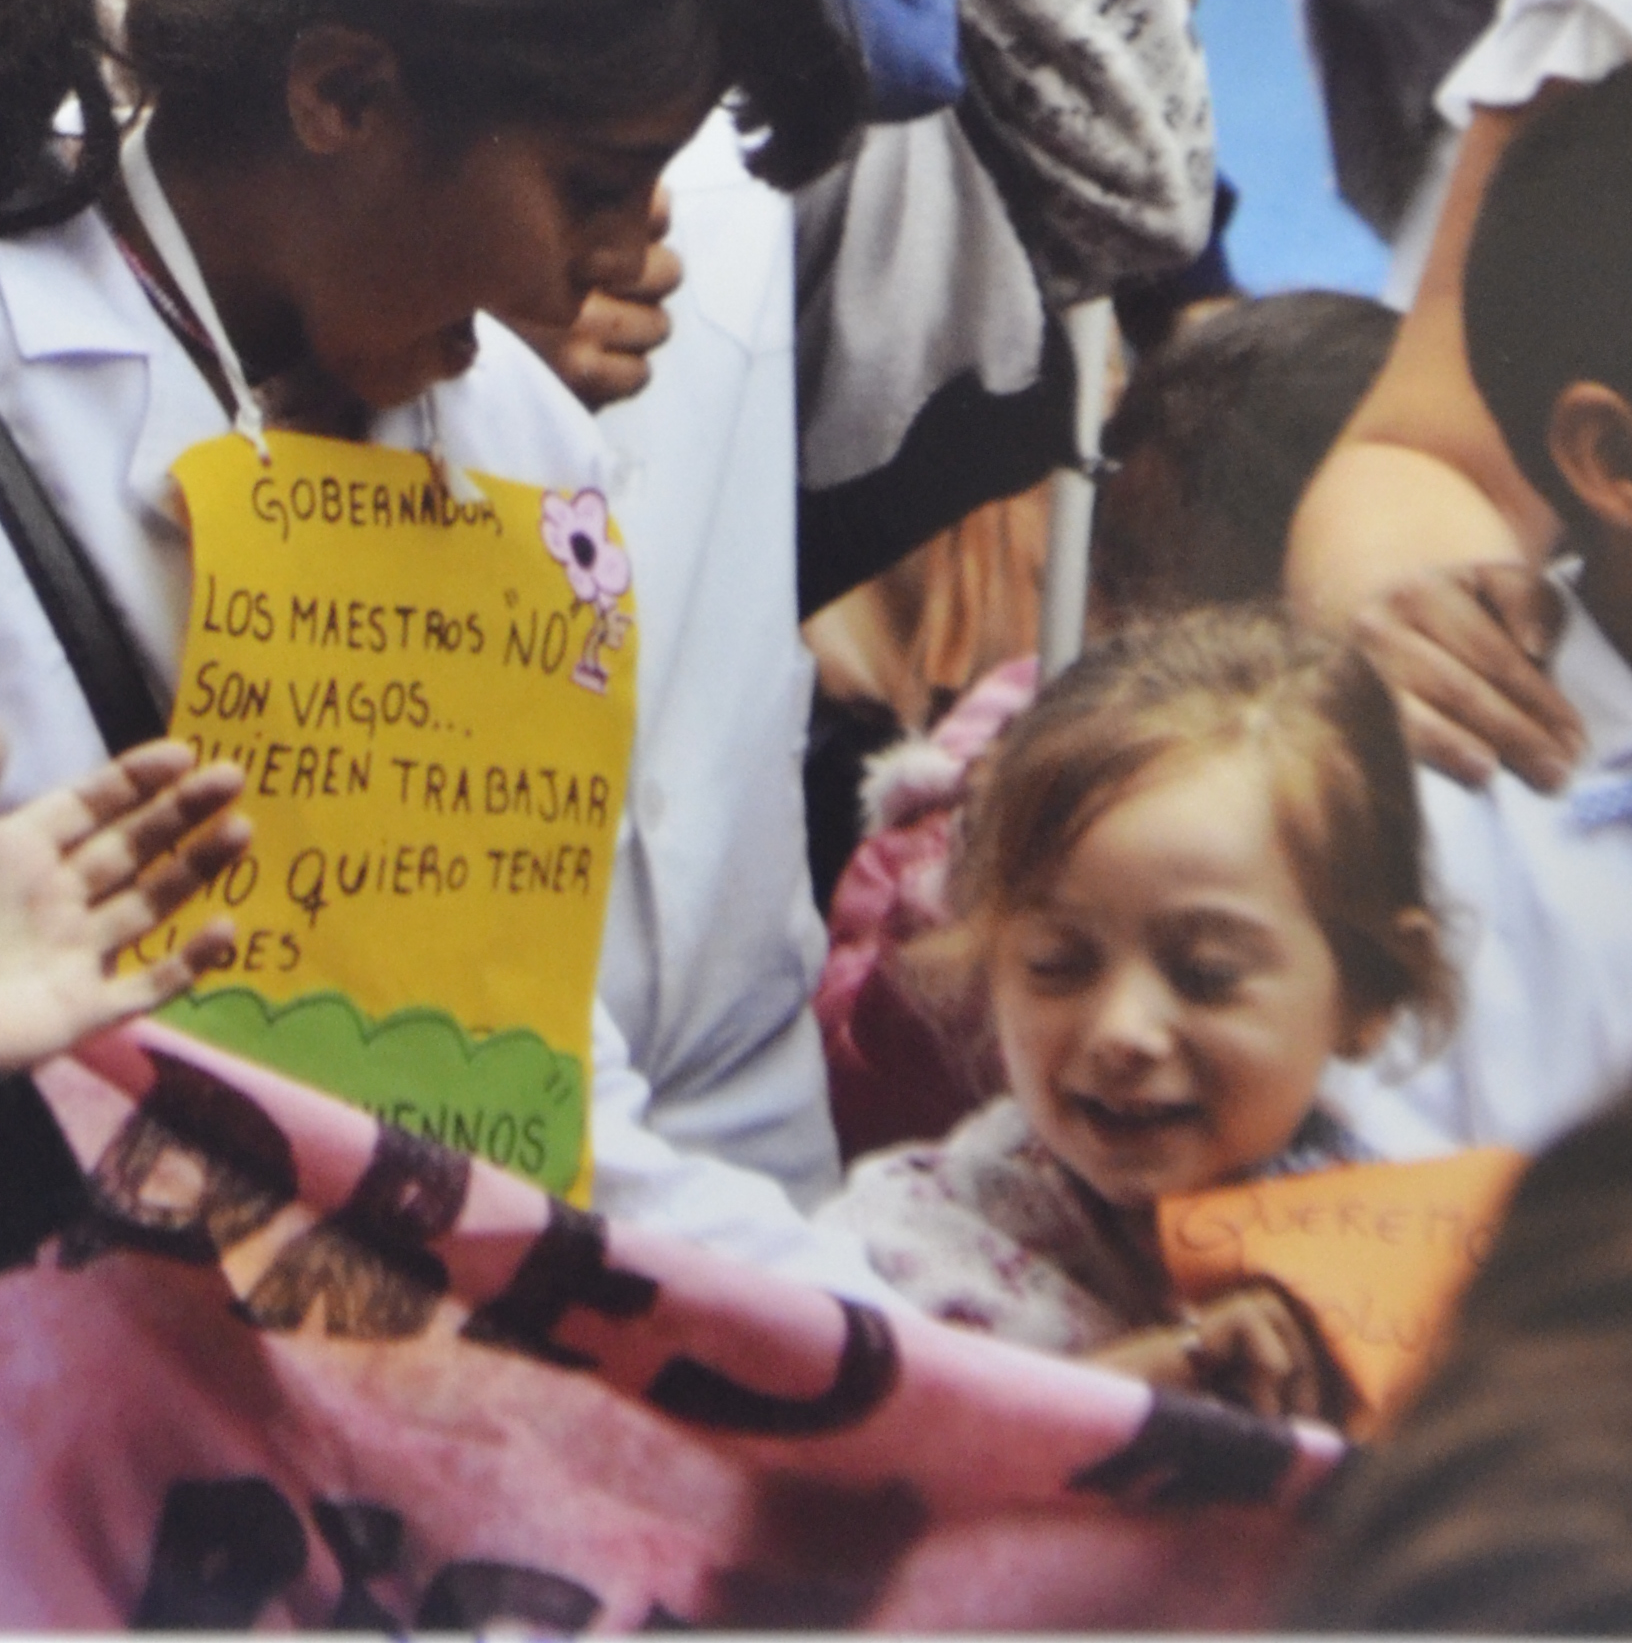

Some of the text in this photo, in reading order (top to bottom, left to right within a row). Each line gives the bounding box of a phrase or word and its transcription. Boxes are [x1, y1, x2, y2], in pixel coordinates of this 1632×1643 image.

[203, 575, 273, 642] LOS
[290, 594, 485, 654] MAESTROS
[188, 660, 473, 738] SON VAGOS...
[188, 732, 610, 827] IEREN TRABAJAR
[205, 854, 259, 907] O
[486, 845, 593, 896] TENER
